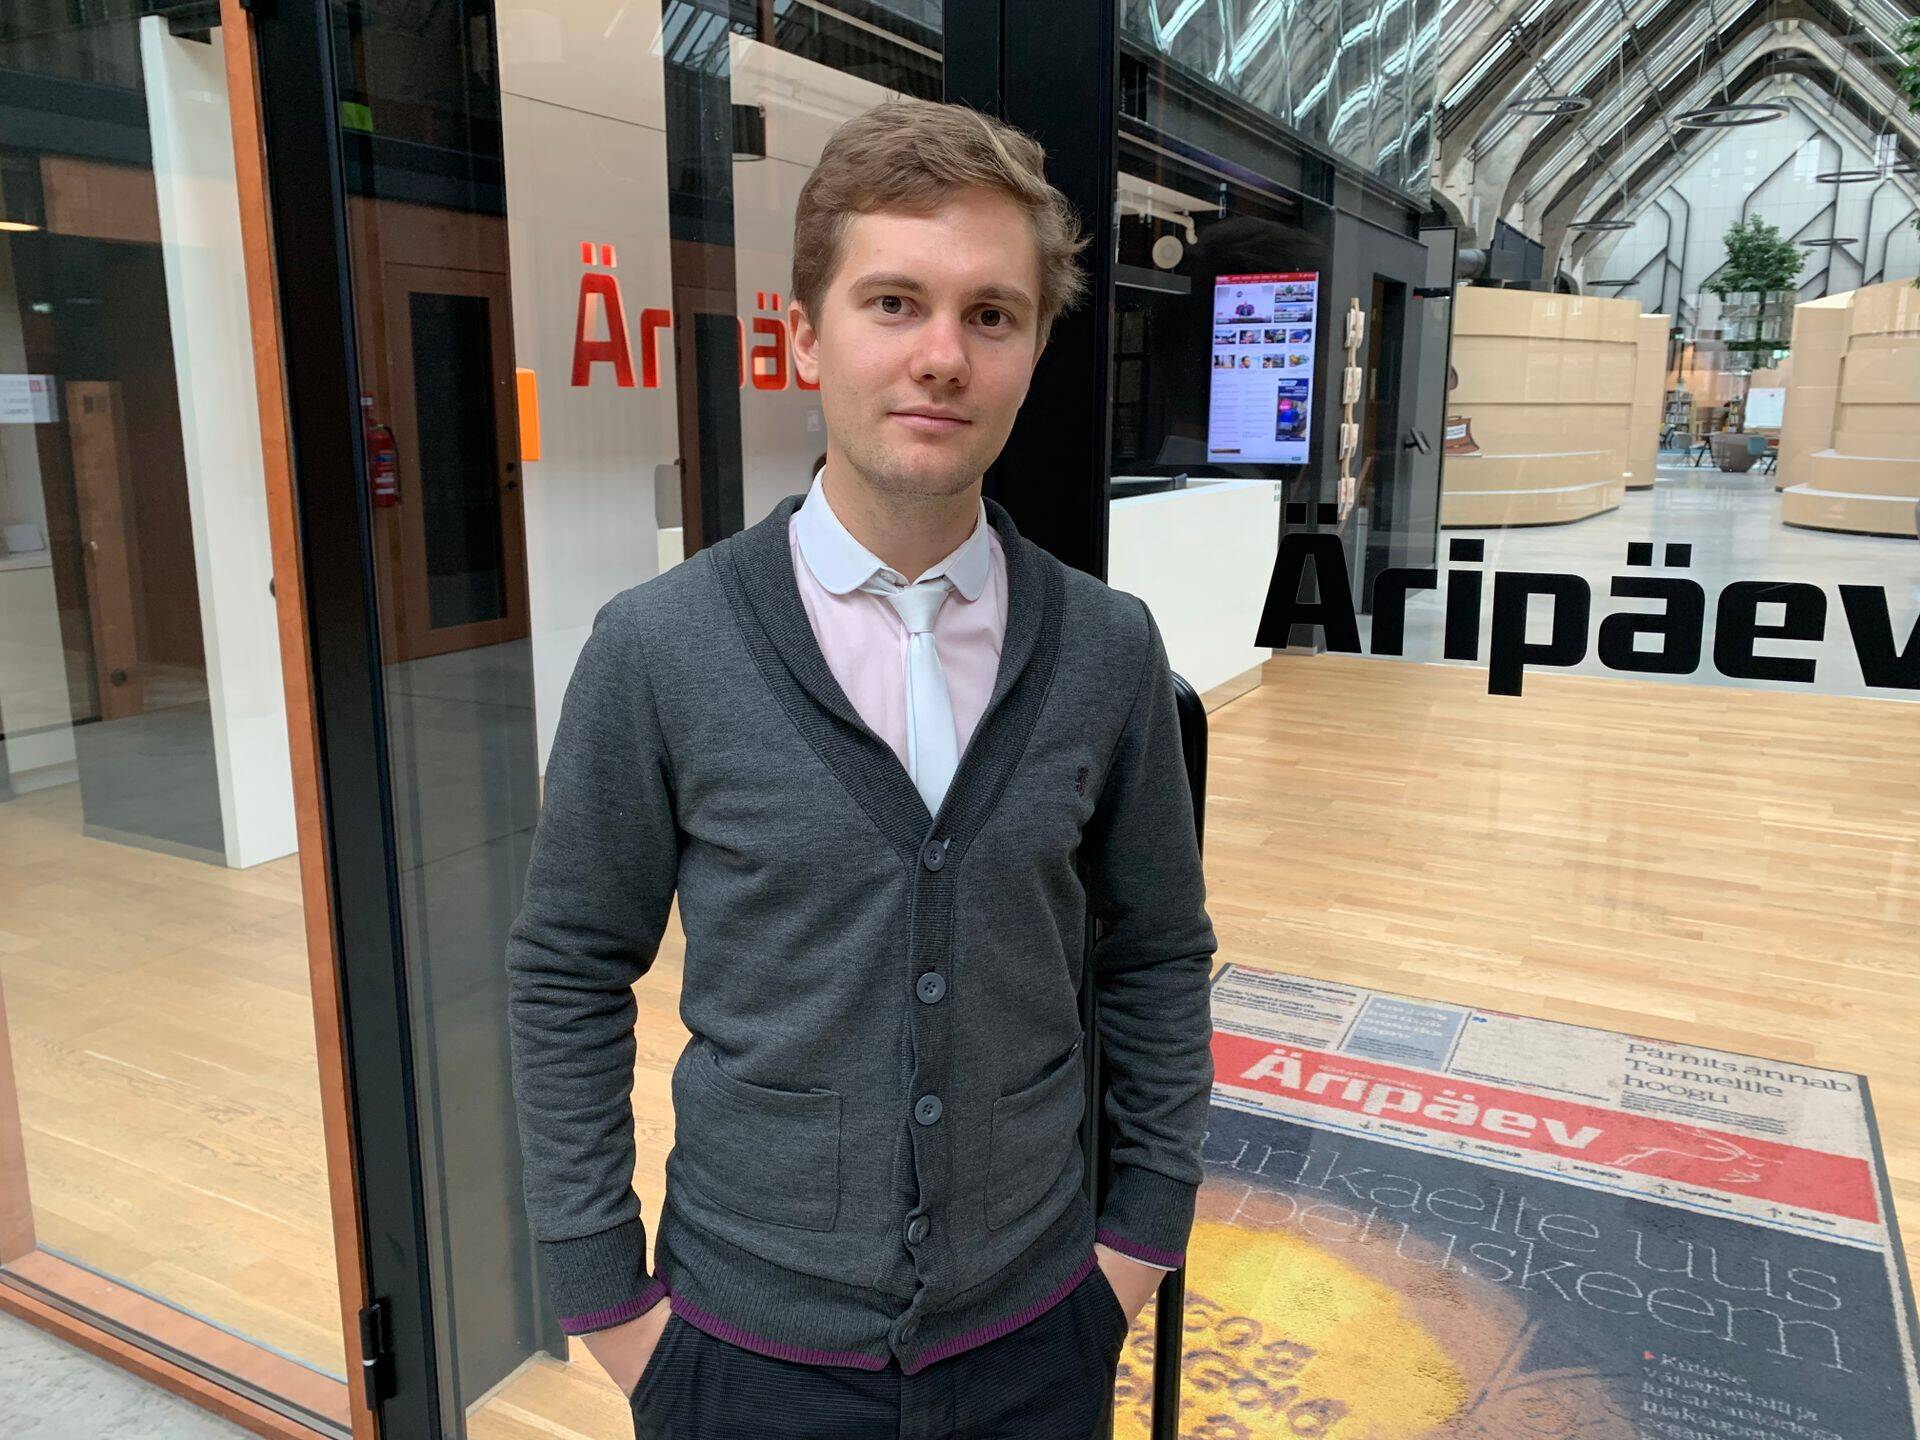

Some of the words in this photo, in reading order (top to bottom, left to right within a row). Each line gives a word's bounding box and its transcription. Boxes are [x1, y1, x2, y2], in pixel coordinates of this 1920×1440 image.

[1254, 502, 1920, 697] Äripäev
[1240, 1048, 1603, 1150] Äripäev
[1624, 1073, 1730, 1105] hoogu
[1743, 1066, 1853, 1093] annab
[1224, 1184, 1856, 1374] petuskeem
[1626, 1229, 1842, 1311] uus
